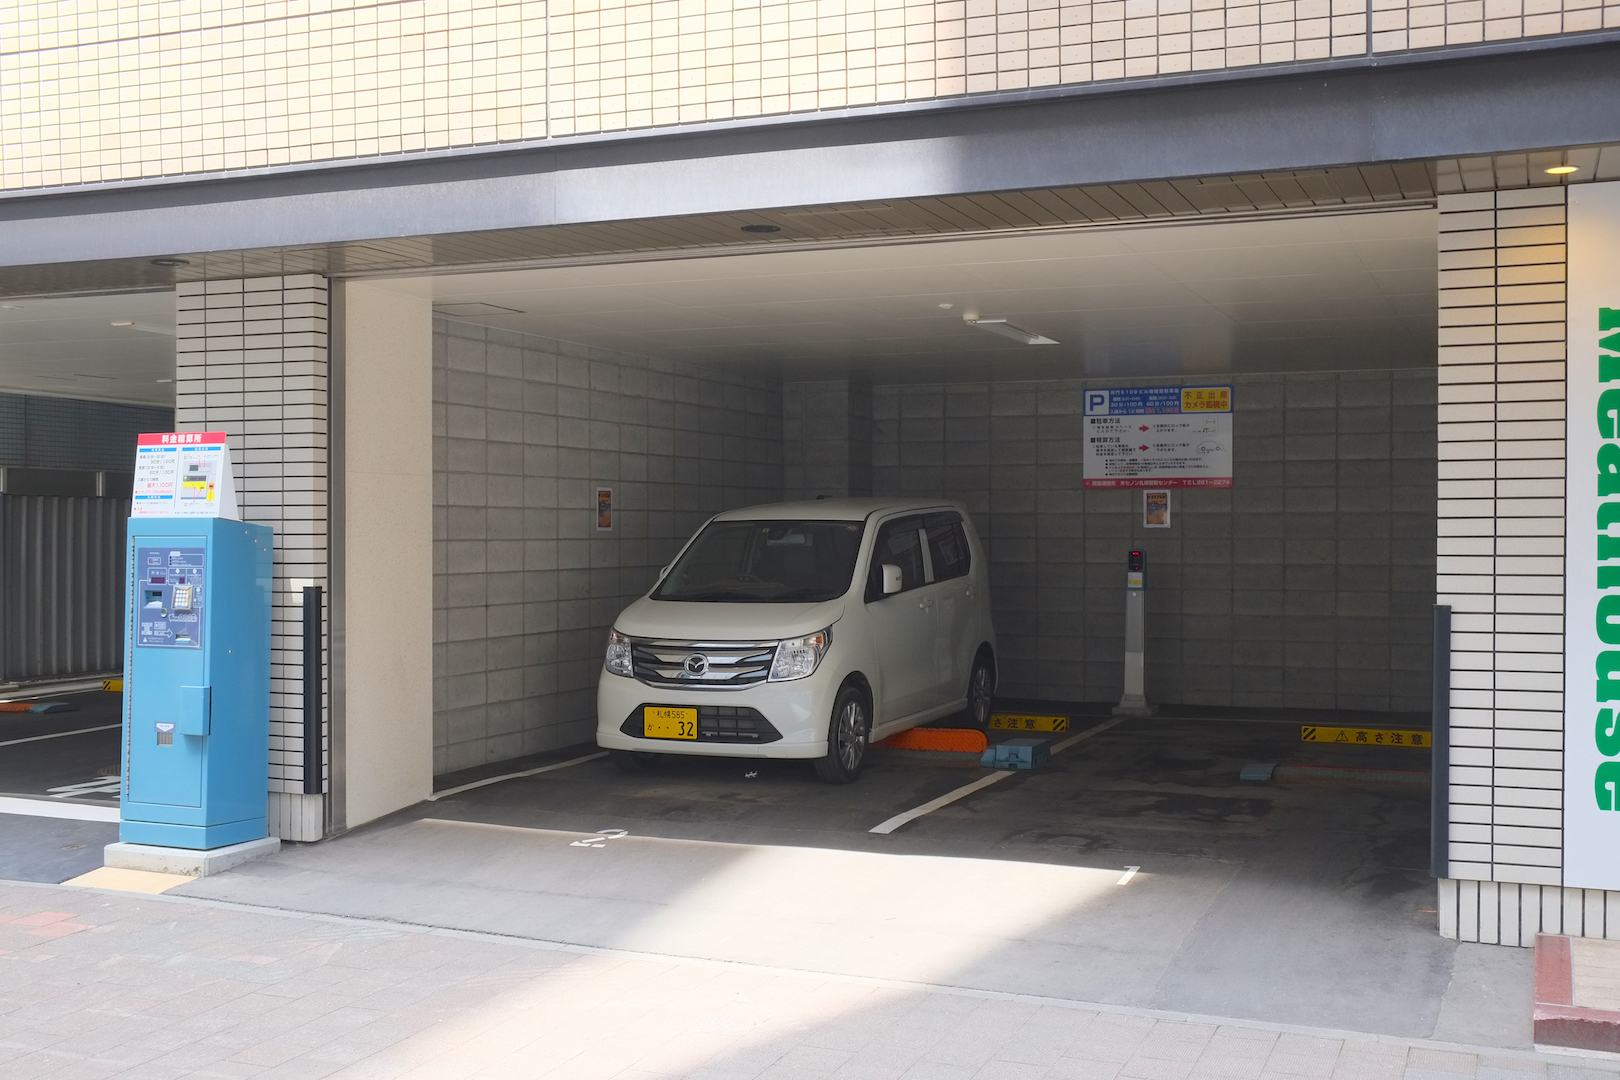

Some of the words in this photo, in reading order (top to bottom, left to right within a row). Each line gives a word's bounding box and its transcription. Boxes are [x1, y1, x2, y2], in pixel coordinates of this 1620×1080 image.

[1184, 391, 1227, 400] 不正出庫
[1090, 394, 1104, 412] P
[1184, 401, 1227, 409] カメラ監視中
[161, 433, 202, 444] 料金精算所
[1356, 731, 1423, 745] 高さ注意
